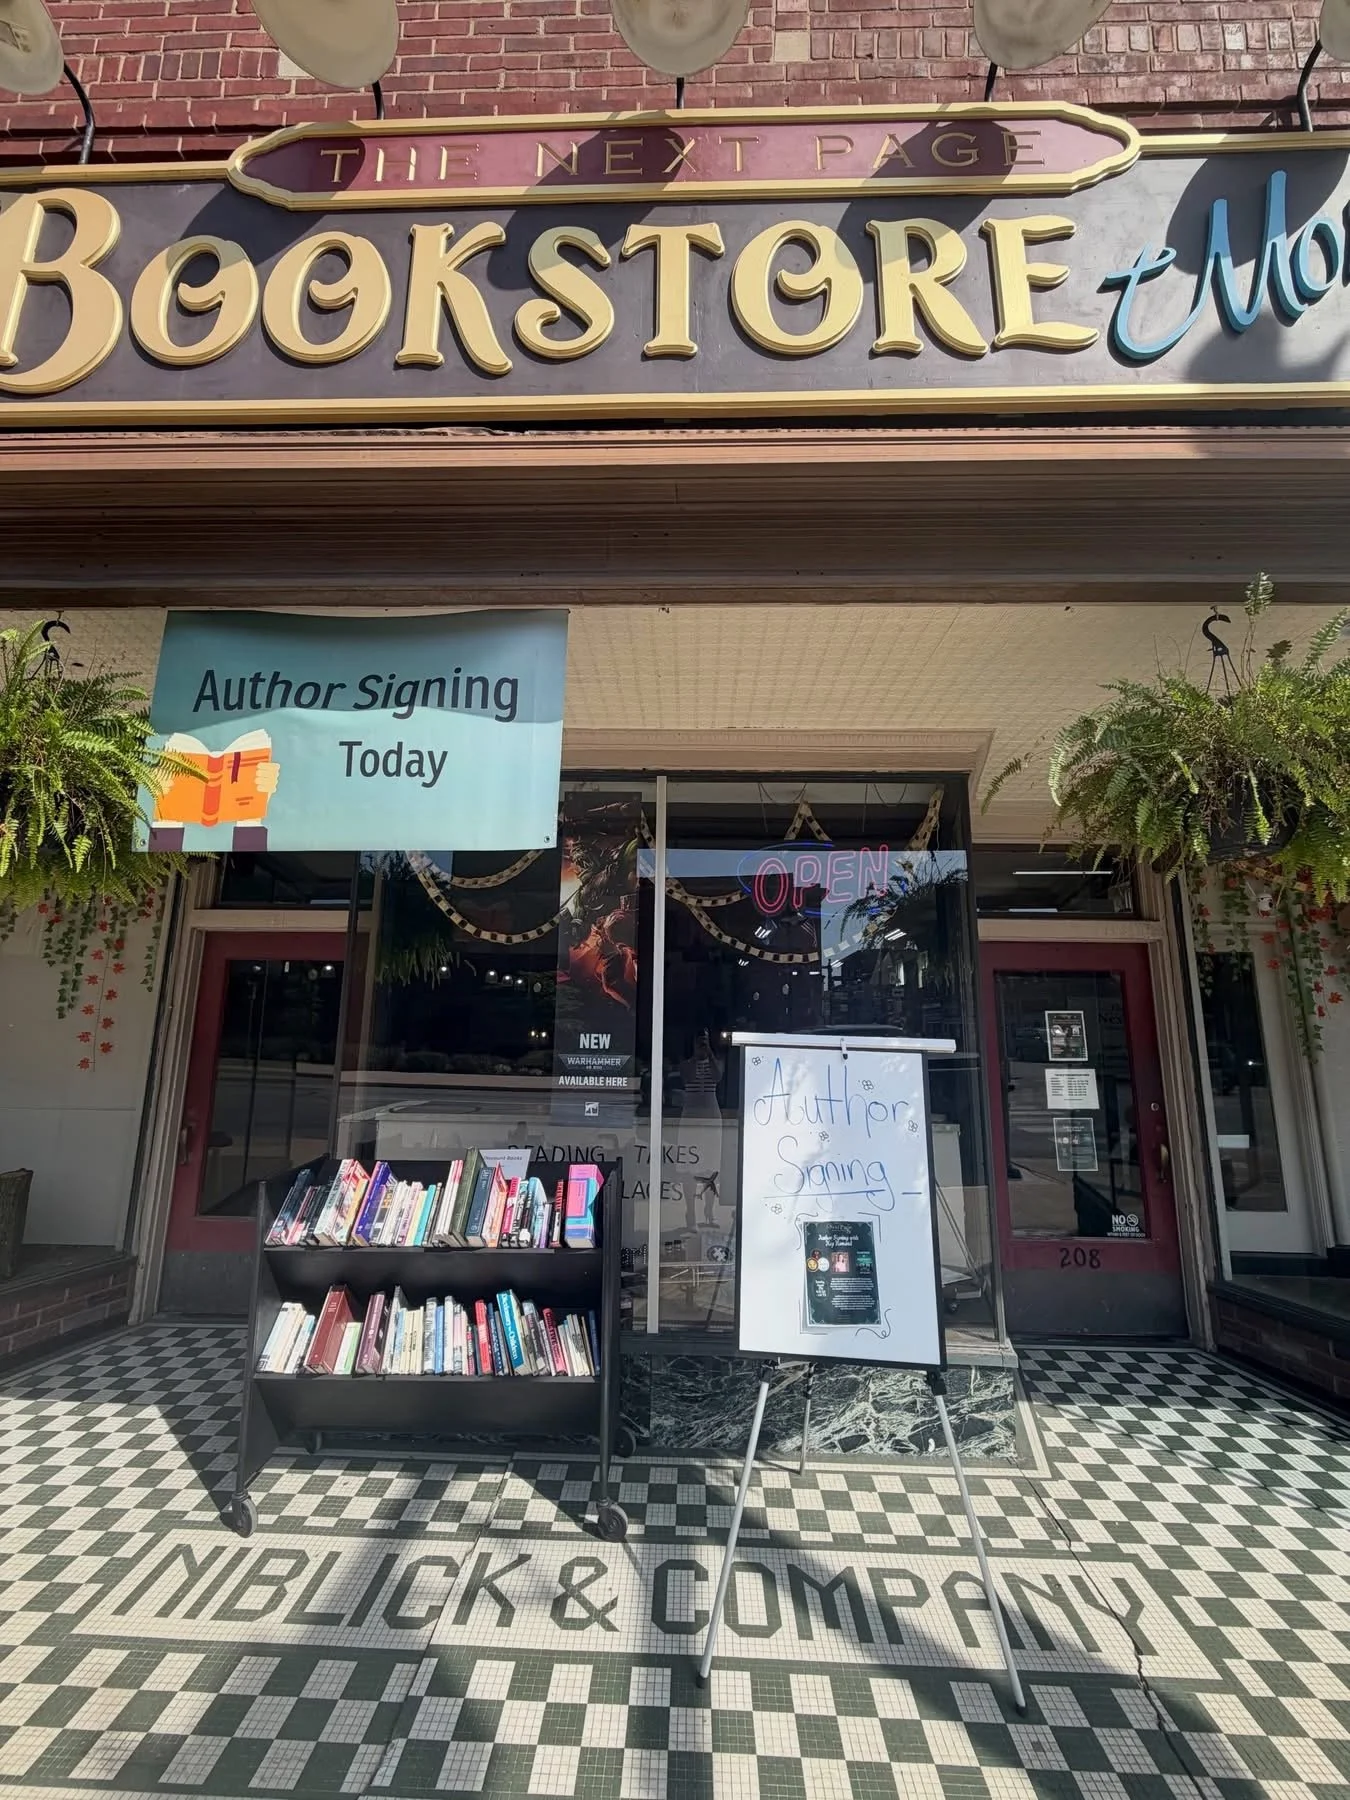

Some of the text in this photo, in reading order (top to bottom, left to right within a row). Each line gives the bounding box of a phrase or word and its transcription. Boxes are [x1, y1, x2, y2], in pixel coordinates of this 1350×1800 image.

[320, 129, 1046, 184] THE NEXT PAGE
[0, 187, 1101, 394] BOOKSTORE
[192, 667, 519, 723] Author Signing
[338, 740, 449, 789] Today
[753, 843, 890, 917] OPEN
[567, 1057, 621, 1066] WARHAMMER
[579, 1033, 611, 1049] NEW
[558, 1075, 628, 1087] AVAILABLE HERE
[752, 1056, 909, 1139] Author
[507, 1144, 700, 1165] ADING TKES
[773, 1134, 896, 1212] Signing
[621, 1180, 684, 1202] LAES
[1111, 1214, 1126, 1225] NO
[1059, 1247, 1102, 1270] 208
[110, 1542, 1160, 1657] NIBLICK & COMPANY
